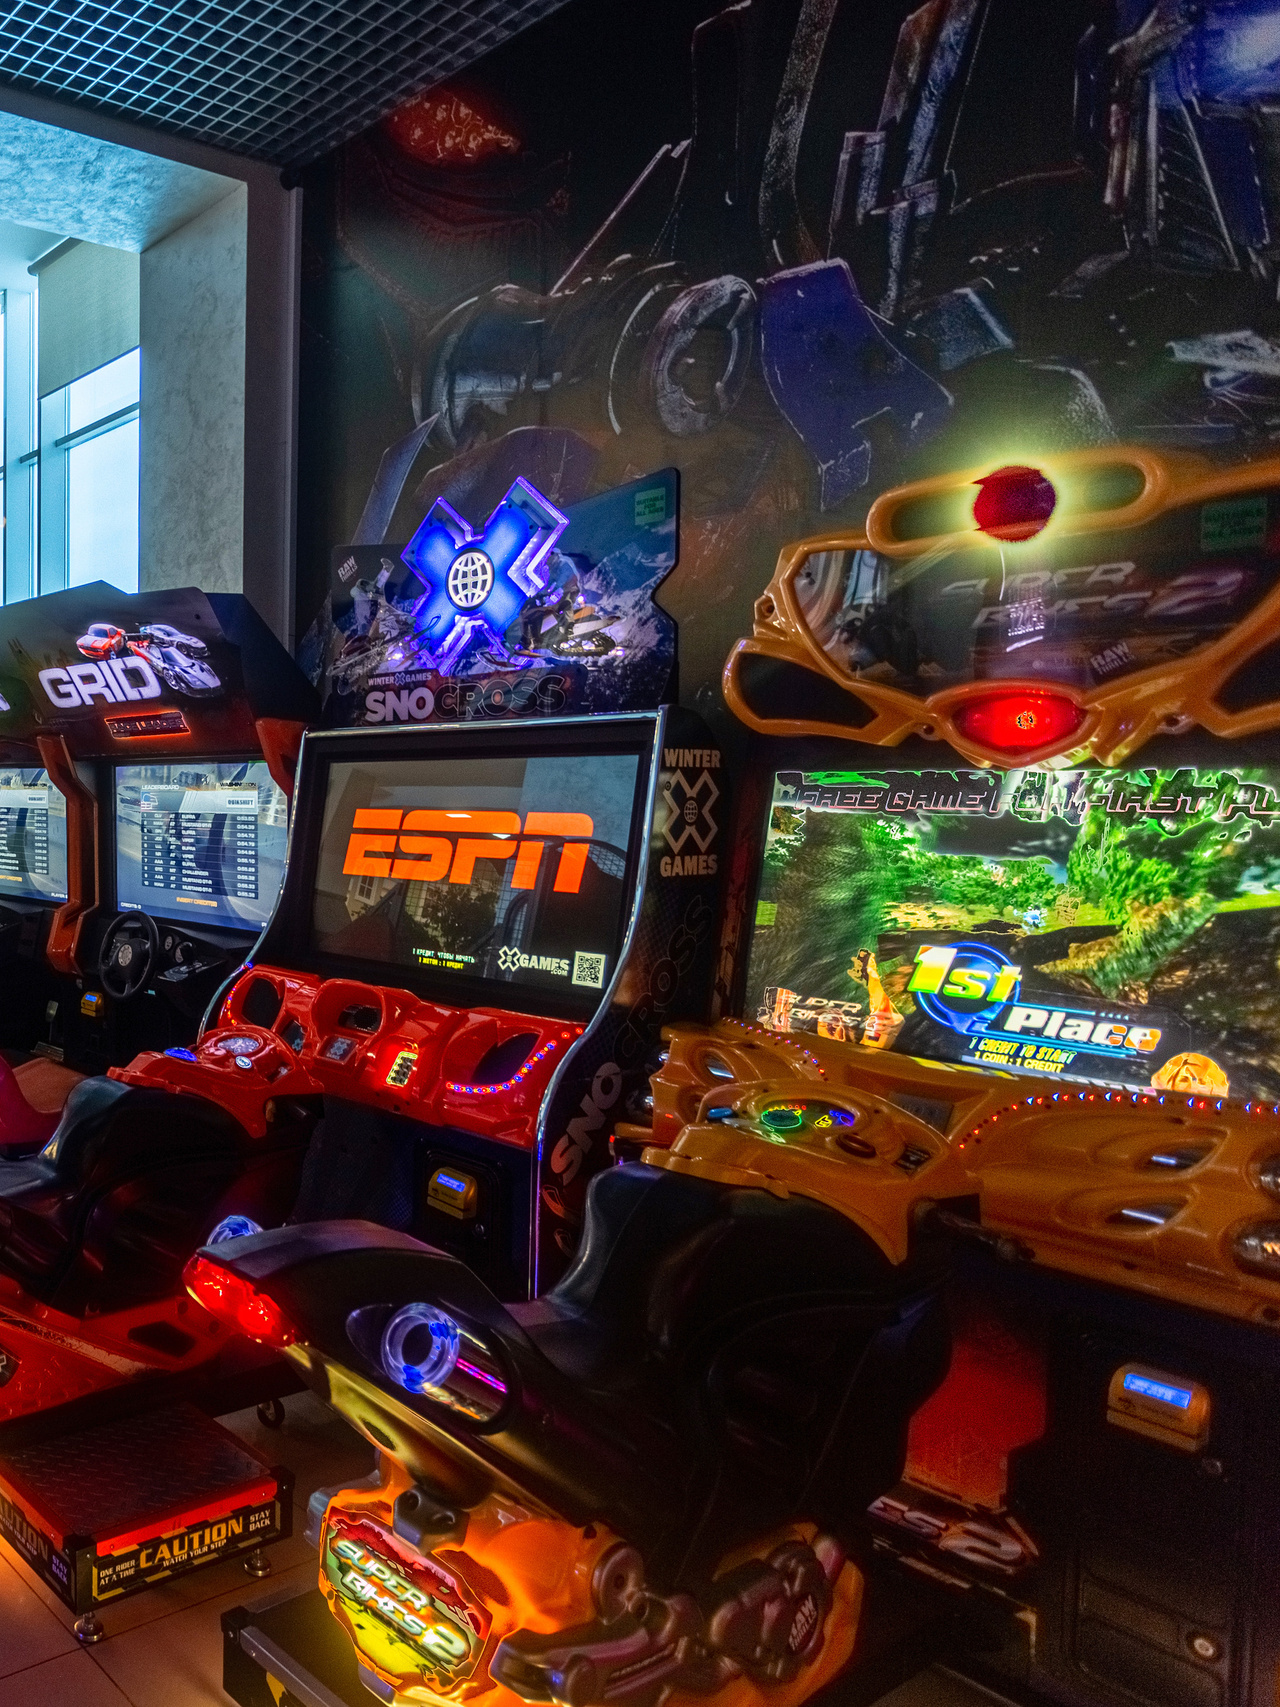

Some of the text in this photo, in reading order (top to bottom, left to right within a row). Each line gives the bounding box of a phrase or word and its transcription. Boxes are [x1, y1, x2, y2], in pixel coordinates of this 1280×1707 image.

[337, 555, 355, 578] RAW
[1090, 641, 1130, 671] RAW
[38, 656, 162, 709] GRID
[368, 676, 394, 686] WINTER
[406, 672, 432, 684] GAMES
[664, 748, 721, 768] WINTER
[796, 789, 884, 811] FREE
[885, 790, 988, 812] GAME
[1088, 789, 1214, 814] FIRST
[343, 808, 594, 893] ESPN
[660, 854, 718, 877] GAMES
[520, 954, 570, 972] GAMES
[907, 945, 1022, 1002] 1st
[1004, 1006, 1162, 1051] Place
[969, 1036, 1078, 1064] 1 CREDIT TO START
[974, 1052, 982, 1060] 1
[982, 1052, 1008, 1065] COIN
[1016, 1056, 1022, 1066] 1
[1024, 1058, 1064, 1073] CREDIT
[249, 1518, 271, 1532] BACK
[250, 1508, 271, 1524] STAY
[139, 1516, 244, 1569] CAUTION
[163, 1538, 227, 1568] WATCH YOUR STEP
[52, 1554, 68, 1576] STAY
[52, 1562, 68, 1586] BACK
[100, 1559, 136, 1578] ONE RIDER
[100, 1567, 136, 1586] AT A TIME
[336, 1539, 429, 1612] SUPER
[341, 1570, 466, 1665] BIKES 2
[788, 1594, 814, 1645] RAW
